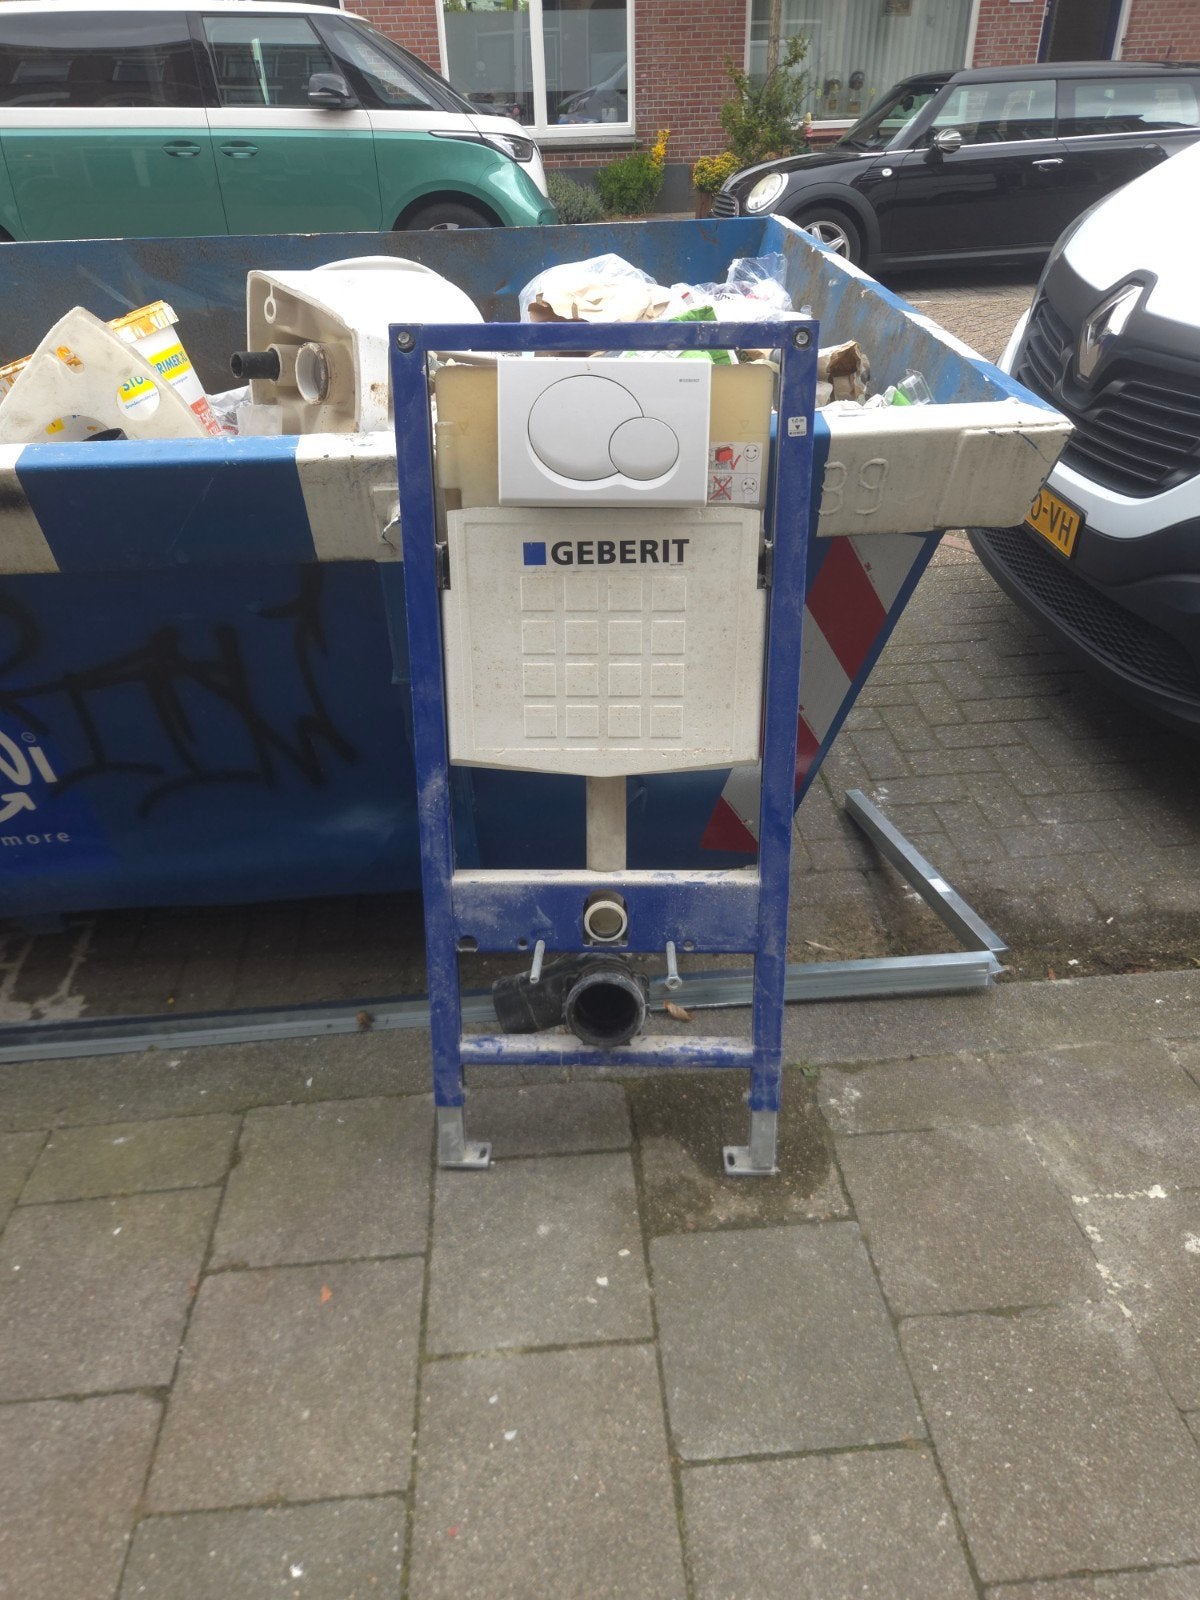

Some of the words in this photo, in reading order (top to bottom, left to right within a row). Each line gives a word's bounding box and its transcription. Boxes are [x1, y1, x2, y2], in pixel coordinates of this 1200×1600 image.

[155, 354, 182, 375] RIMER
[551, 539, 690, 566] GEBERIT
[0, 832, 70, 846] more
